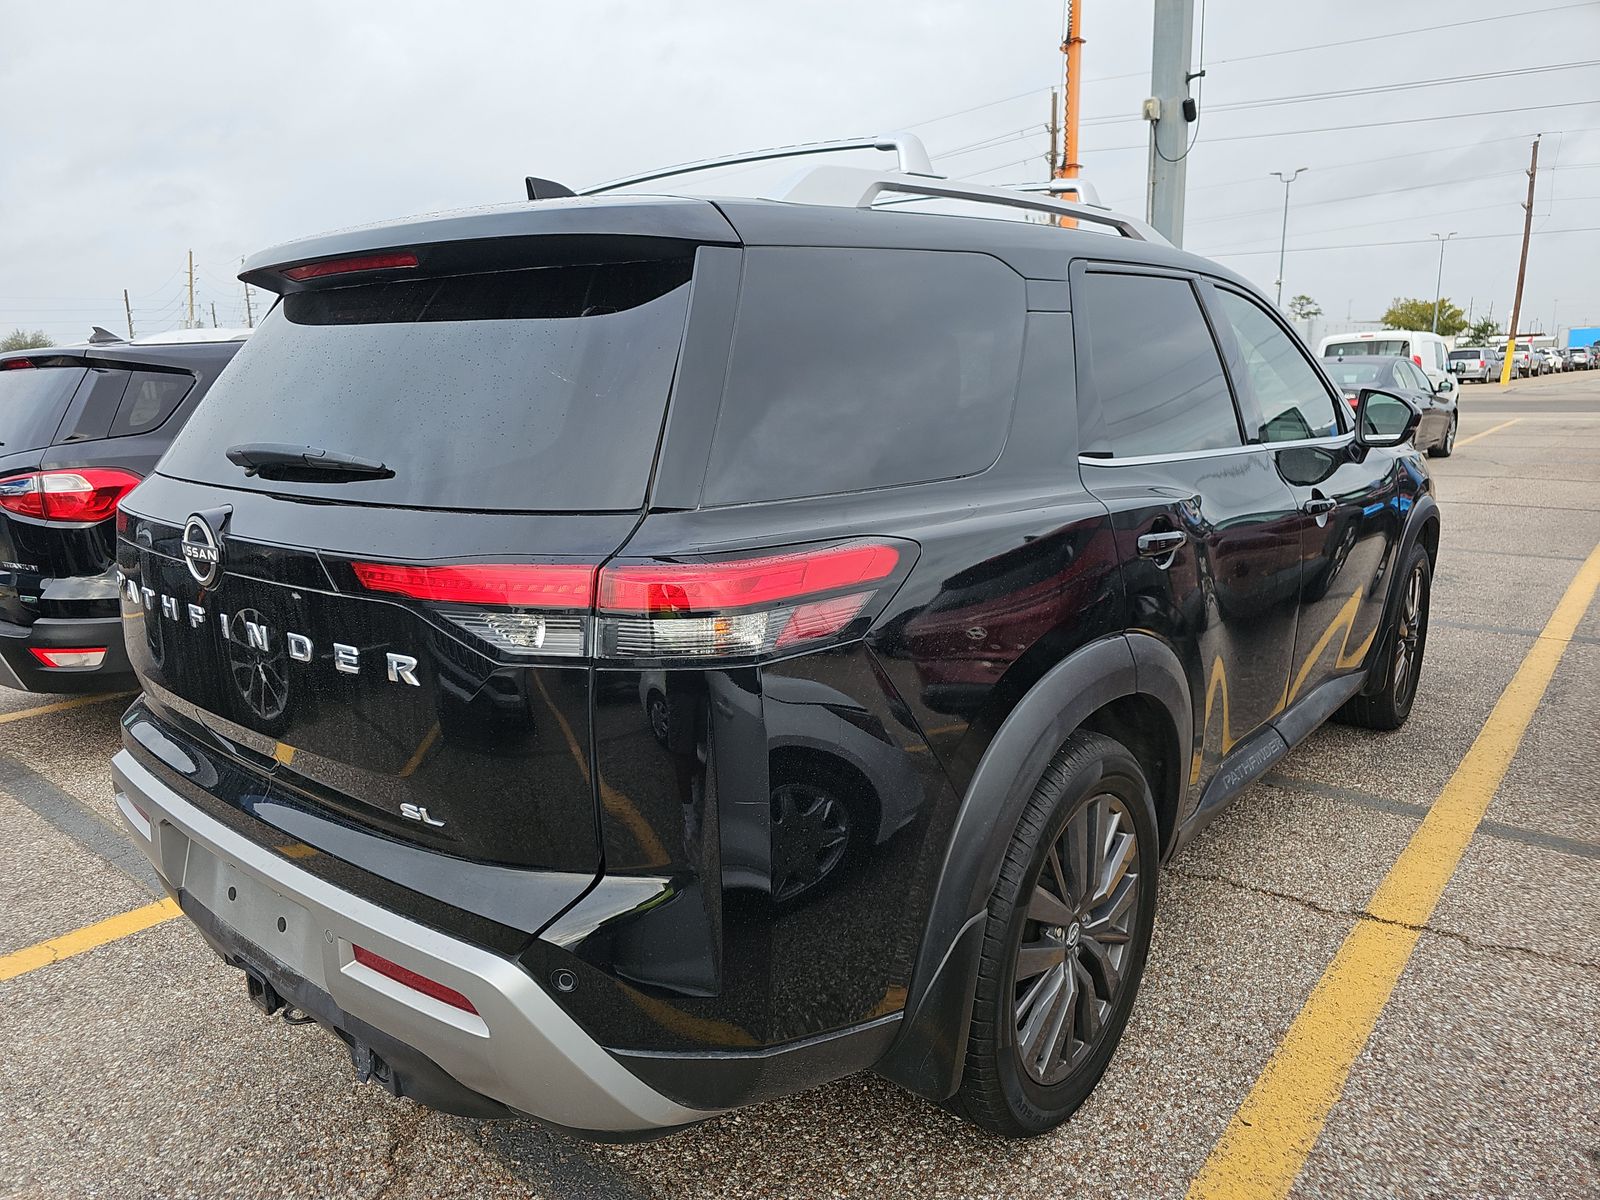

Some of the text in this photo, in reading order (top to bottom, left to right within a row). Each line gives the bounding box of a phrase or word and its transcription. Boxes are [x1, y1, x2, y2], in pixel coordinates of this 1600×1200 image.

[116, 570, 421, 687] PATHFINDER
[1223, 737, 1284, 790] PATHFINDER
[399, 803, 446, 827] SL
